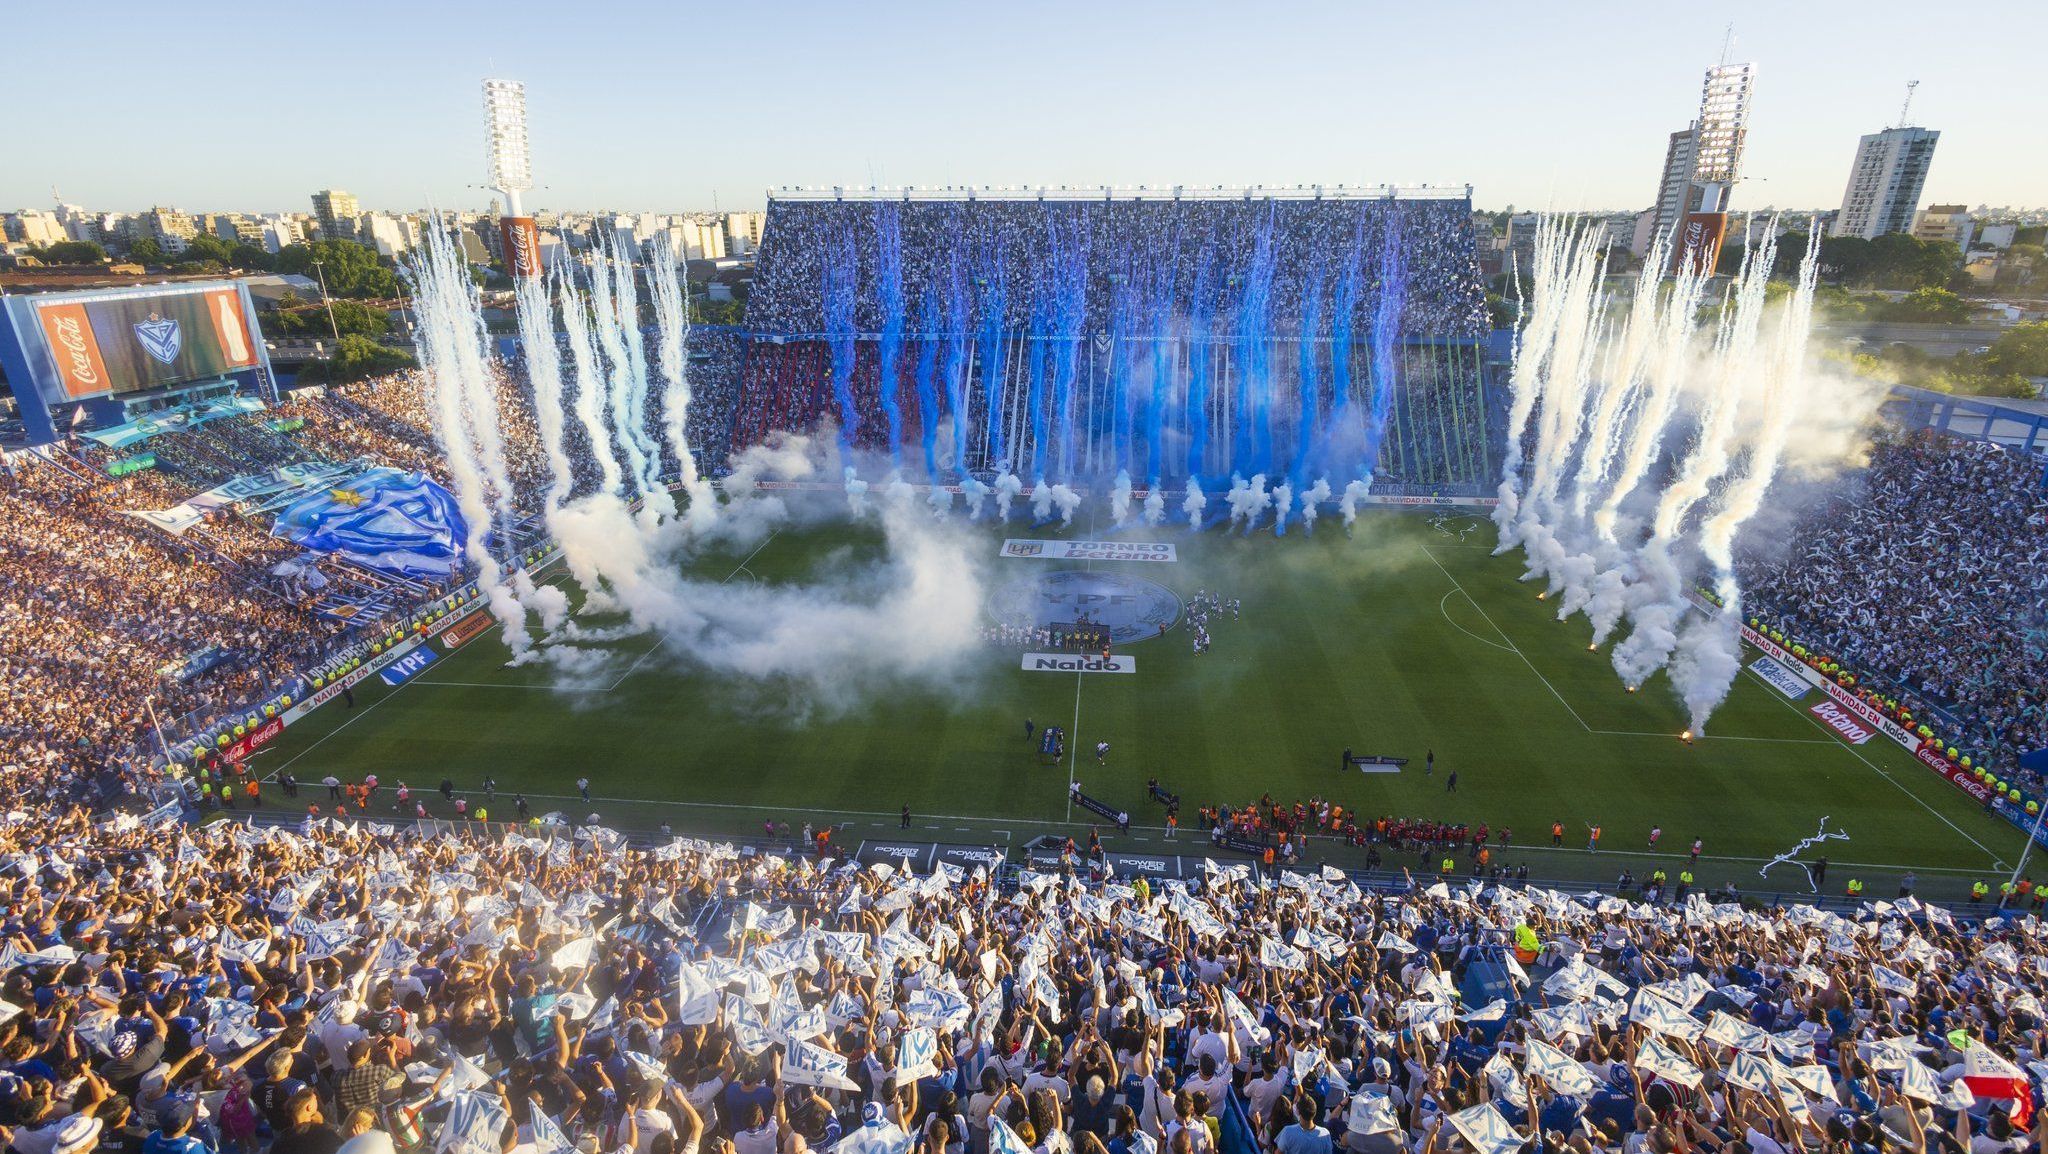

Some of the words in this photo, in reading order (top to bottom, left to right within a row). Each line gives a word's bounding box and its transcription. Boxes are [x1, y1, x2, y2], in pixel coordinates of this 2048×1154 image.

[1067, 542, 1169, 552] TORNEO
[356, 666, 369, 679] EN
[370, 652, 395, 671] Naldo
[391, 650, 427, 676] YPF
[1036, 657, 1121, 671] Naldo
[1770, 646, 1782, 658] EN
[1783, 654, 1804, 673] Naldo
[1811, 701, 1868, 741] Betano
[1830, 686, 1867, 715] NAVIDAD
[1867, 711, 1881, 725] EN
[1882, 720, 1909, 744] Naldo
